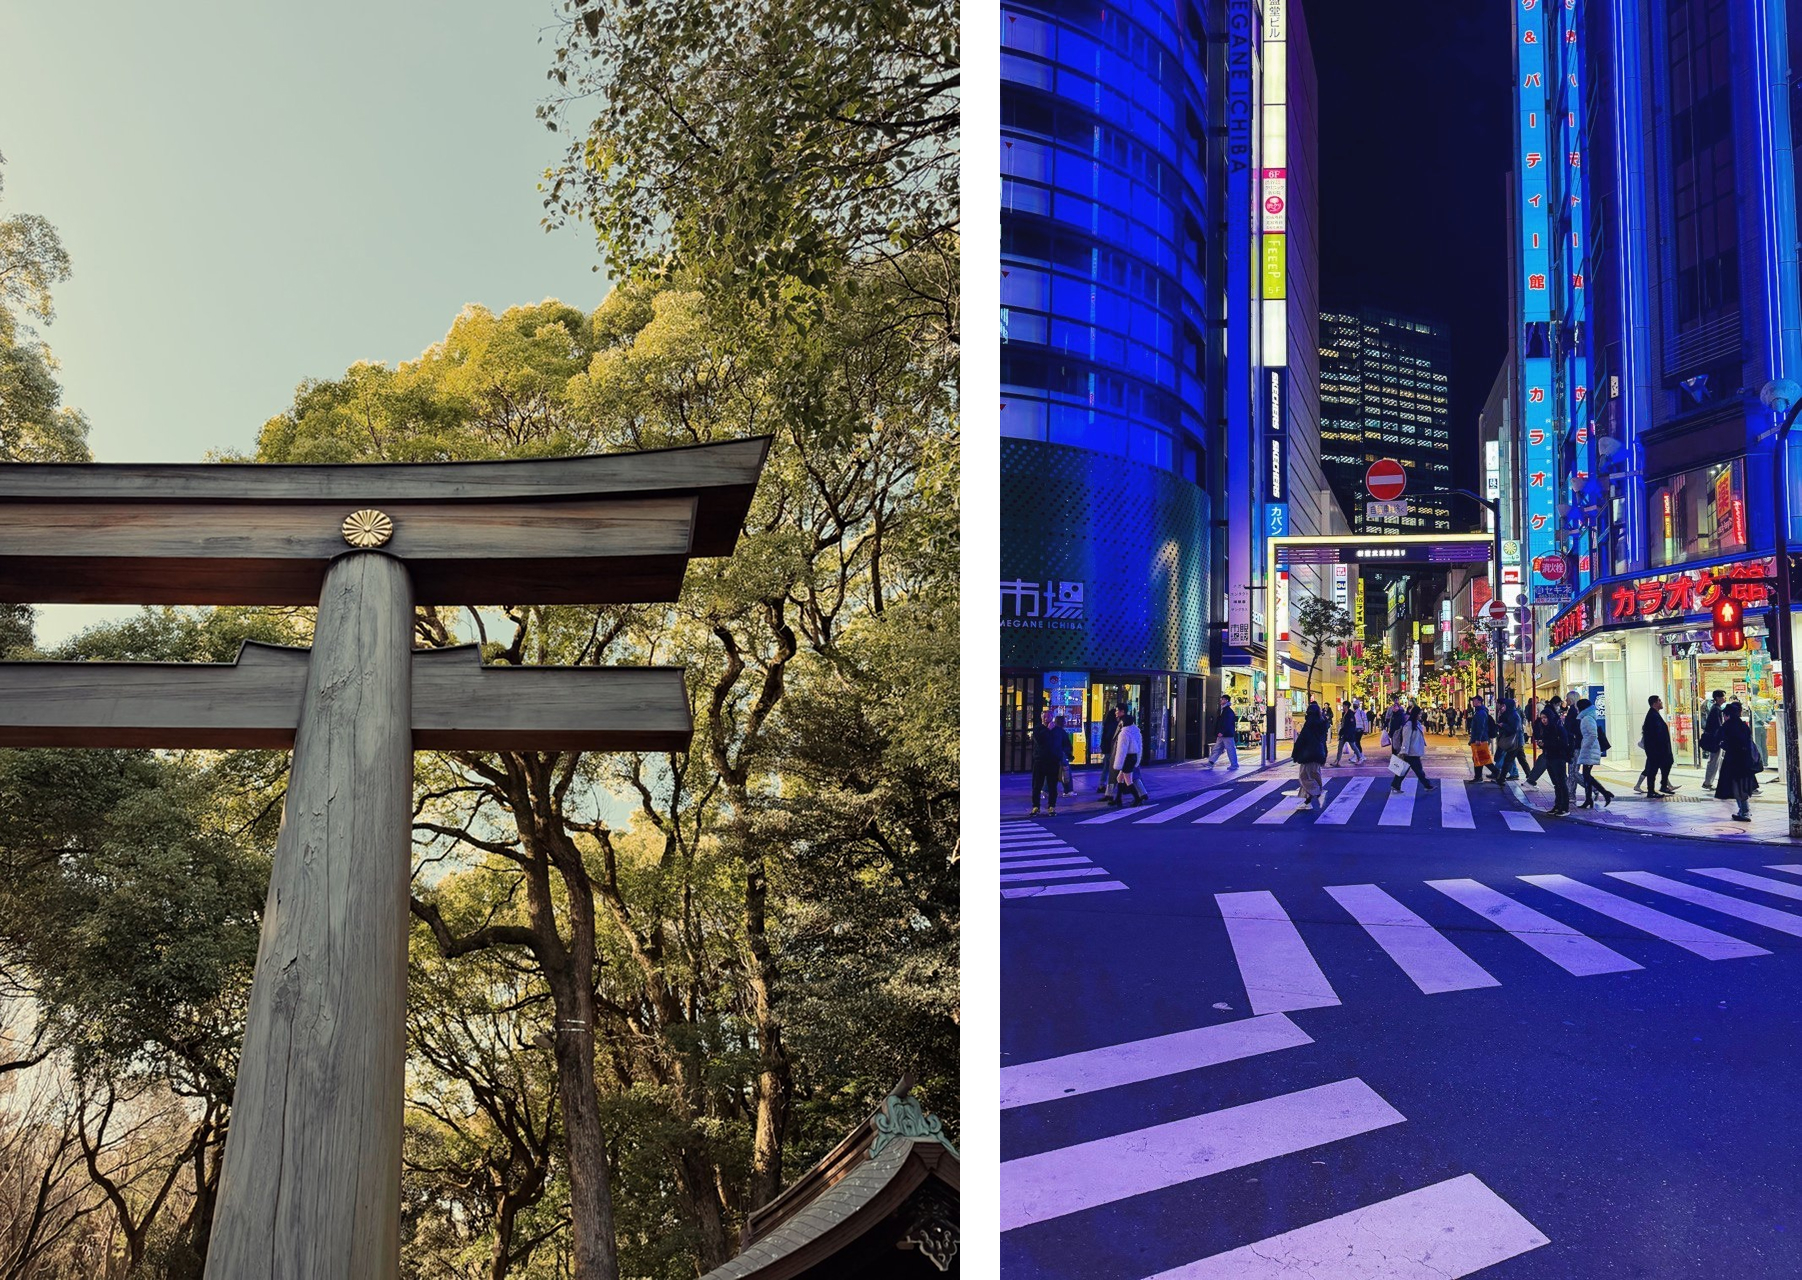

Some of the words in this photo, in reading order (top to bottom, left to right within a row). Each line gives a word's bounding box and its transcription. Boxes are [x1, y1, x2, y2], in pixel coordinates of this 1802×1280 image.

[1231, 92, 1248, 173] ICHIBA
[1268, 171, 1281, 179] 6F
[1271, 371, 1280, 430] SKECHERS
[1272, 439, 1280, 499] SKECHERS
[1270, 506, 1282, 535] カバン
[1541, 563, 1564, 573] 消火栓
[1000, 578, 1084, 619] 市場
[1611, 564, 1768, 618] カラオケ館
[1047, 621, 1083, 630] ICHIBA
